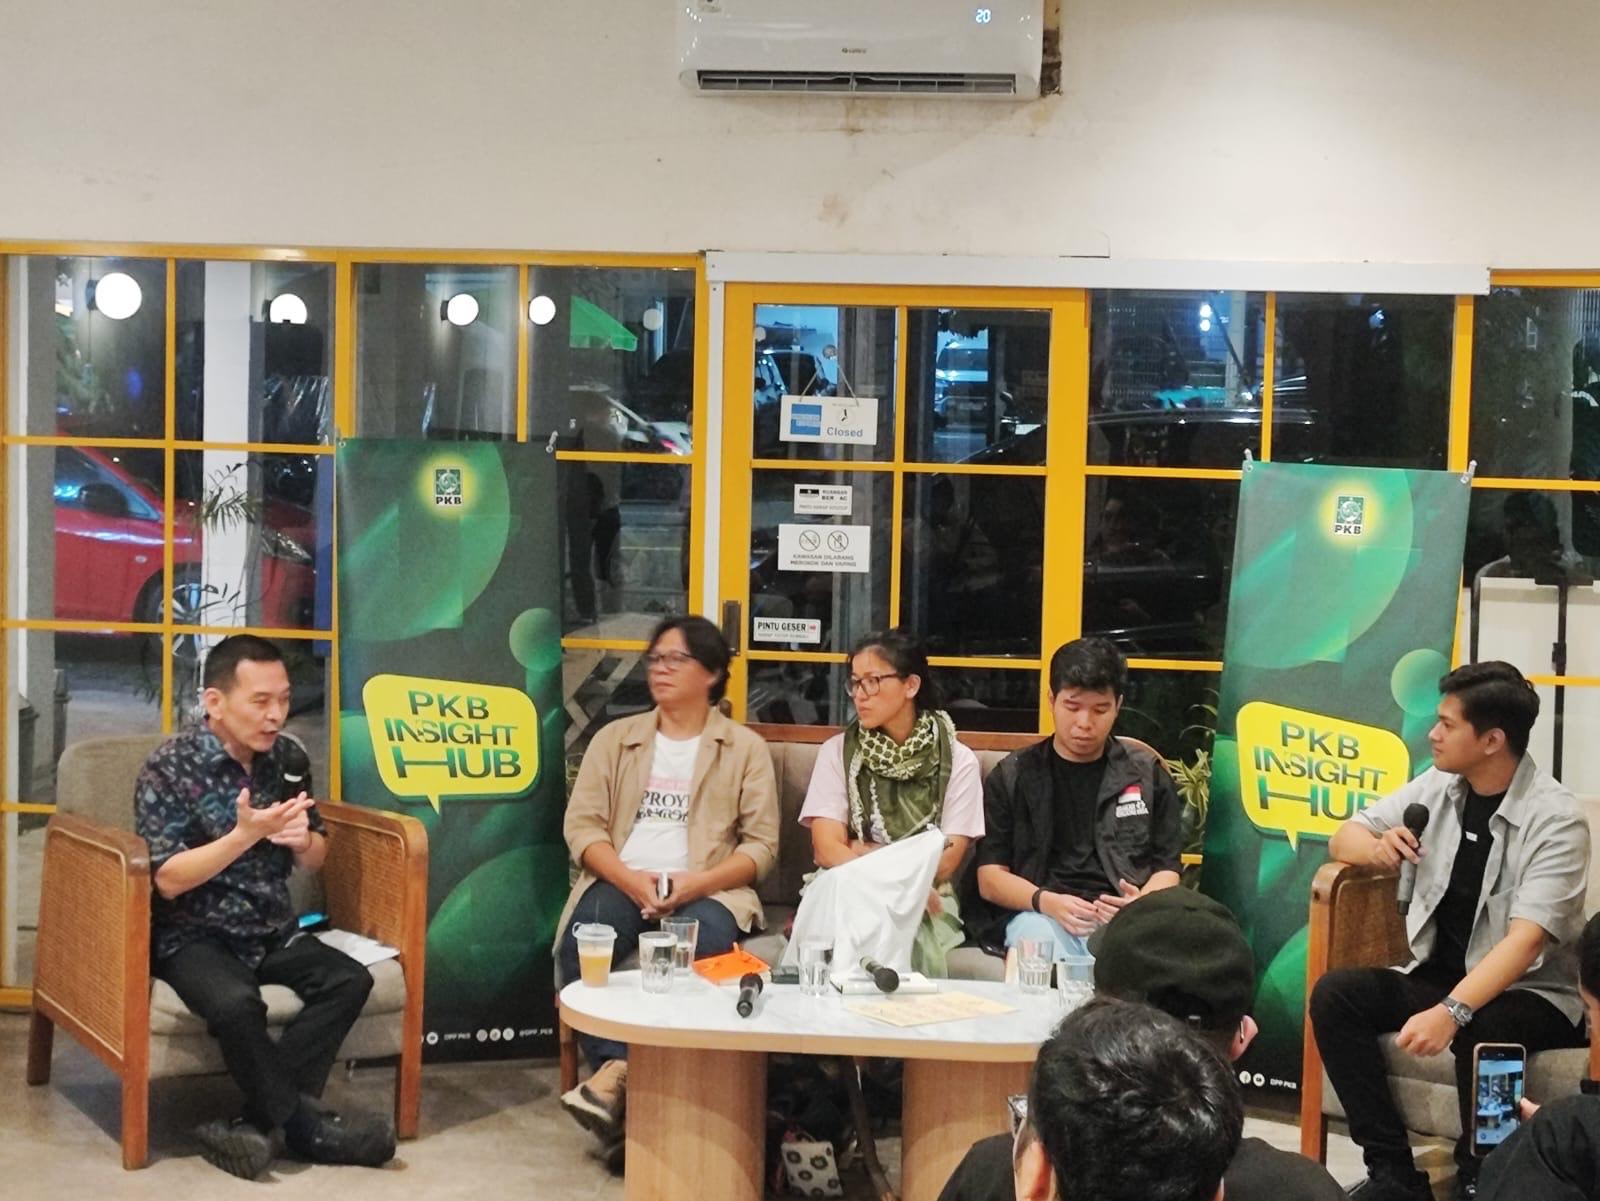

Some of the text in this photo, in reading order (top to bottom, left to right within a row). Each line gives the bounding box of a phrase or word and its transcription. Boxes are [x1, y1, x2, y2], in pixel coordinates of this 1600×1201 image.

[976, 9, 991, 22] 20
[827, 426, 863, 437] Closed
[436, 496, 462, 504] PKB
[1335, 524, 1361, 535] PKB
[758, 621, 806, 631] PINTU GESER
[408, 690, 490, 720] PKB
[384, 717, 519, 746] INSIGHT
[1281, 720, 1360, 760] PKB
[391, 746, 522, 778] HUB
[1254, 746, 1388, 791] INSIGHT
[641, 790, 690, 808] PROY
